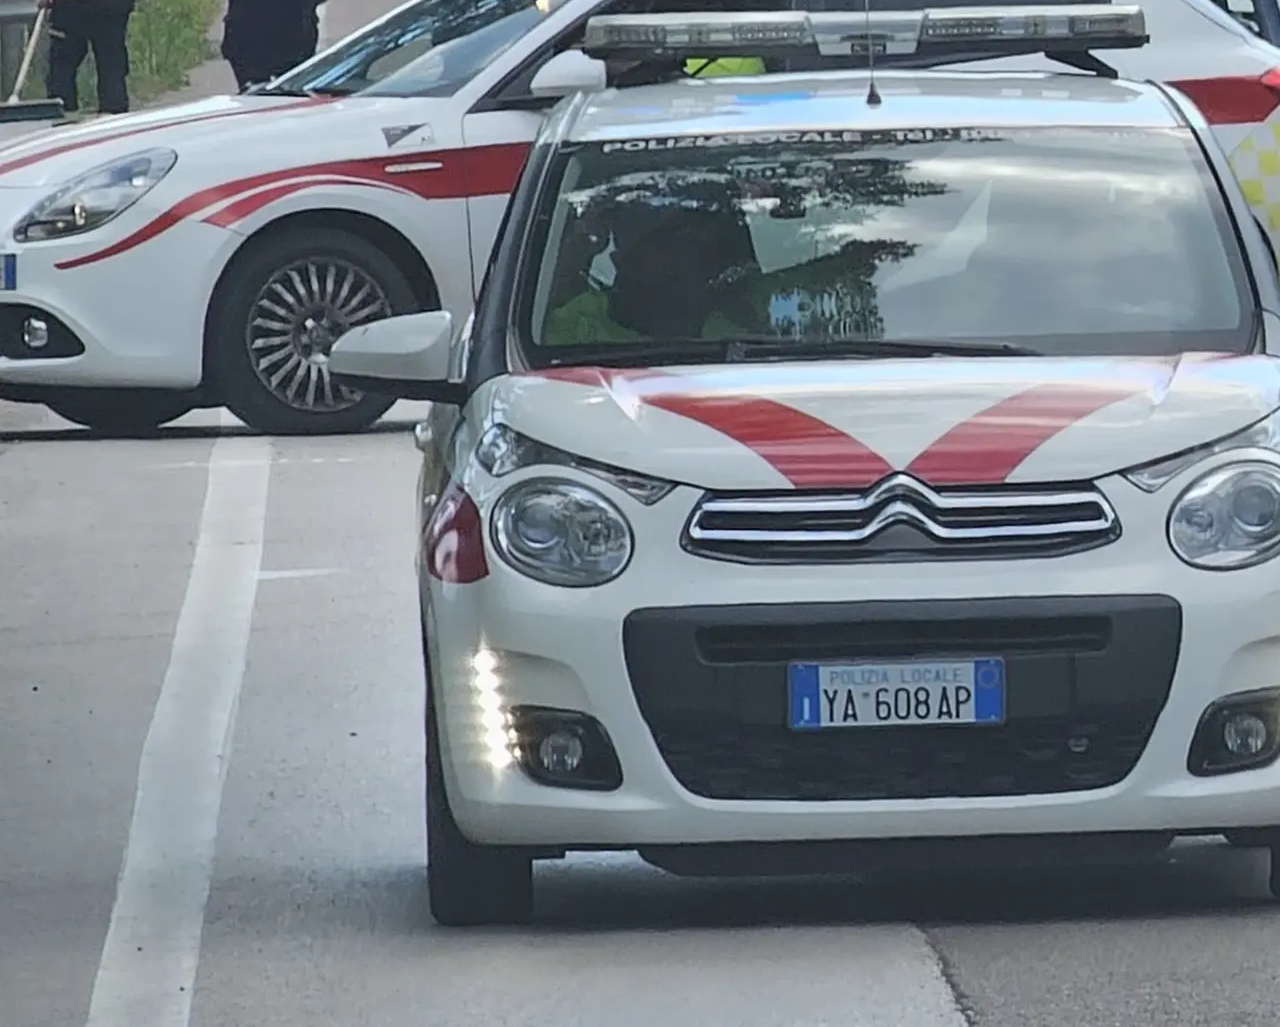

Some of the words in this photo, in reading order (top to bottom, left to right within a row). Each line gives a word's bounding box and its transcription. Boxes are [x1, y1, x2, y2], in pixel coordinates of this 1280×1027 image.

[602, 134, 732, 154] POLIZIA
[737, 129, 863, 145] LOCALE
[829, 669, 890, 685] POLIZIA
[900, 668, 962, 684] LOCALE
[823, 688, 858, 723] YA
